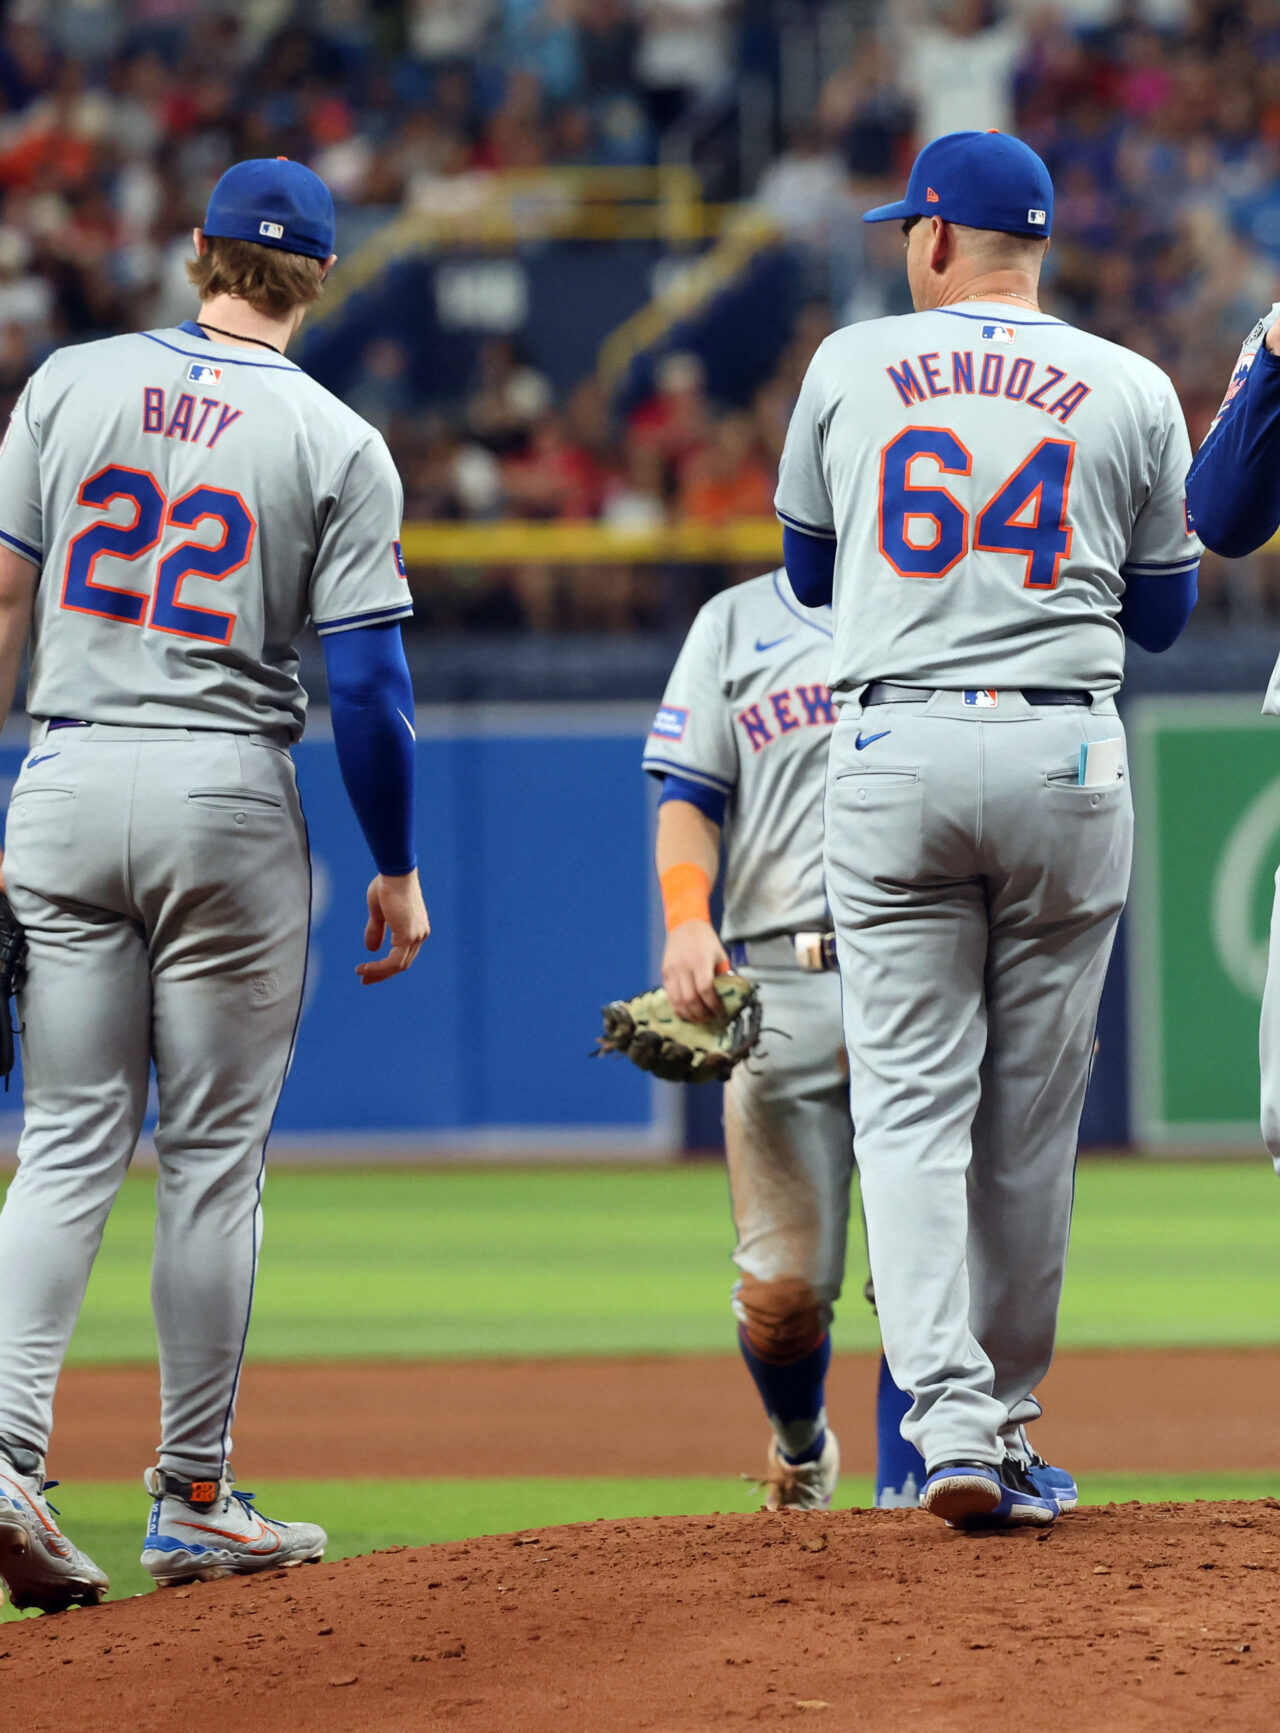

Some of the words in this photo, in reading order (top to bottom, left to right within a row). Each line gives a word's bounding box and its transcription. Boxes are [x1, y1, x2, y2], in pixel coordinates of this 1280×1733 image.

[143, 387, 243, 449] BATY
[886, 351, 1092, 424] MENDOZA
[878, 425, 1076, 589] 64
[60, 463, 257, 646] 22
[738, 683, 838, 754] NEW
